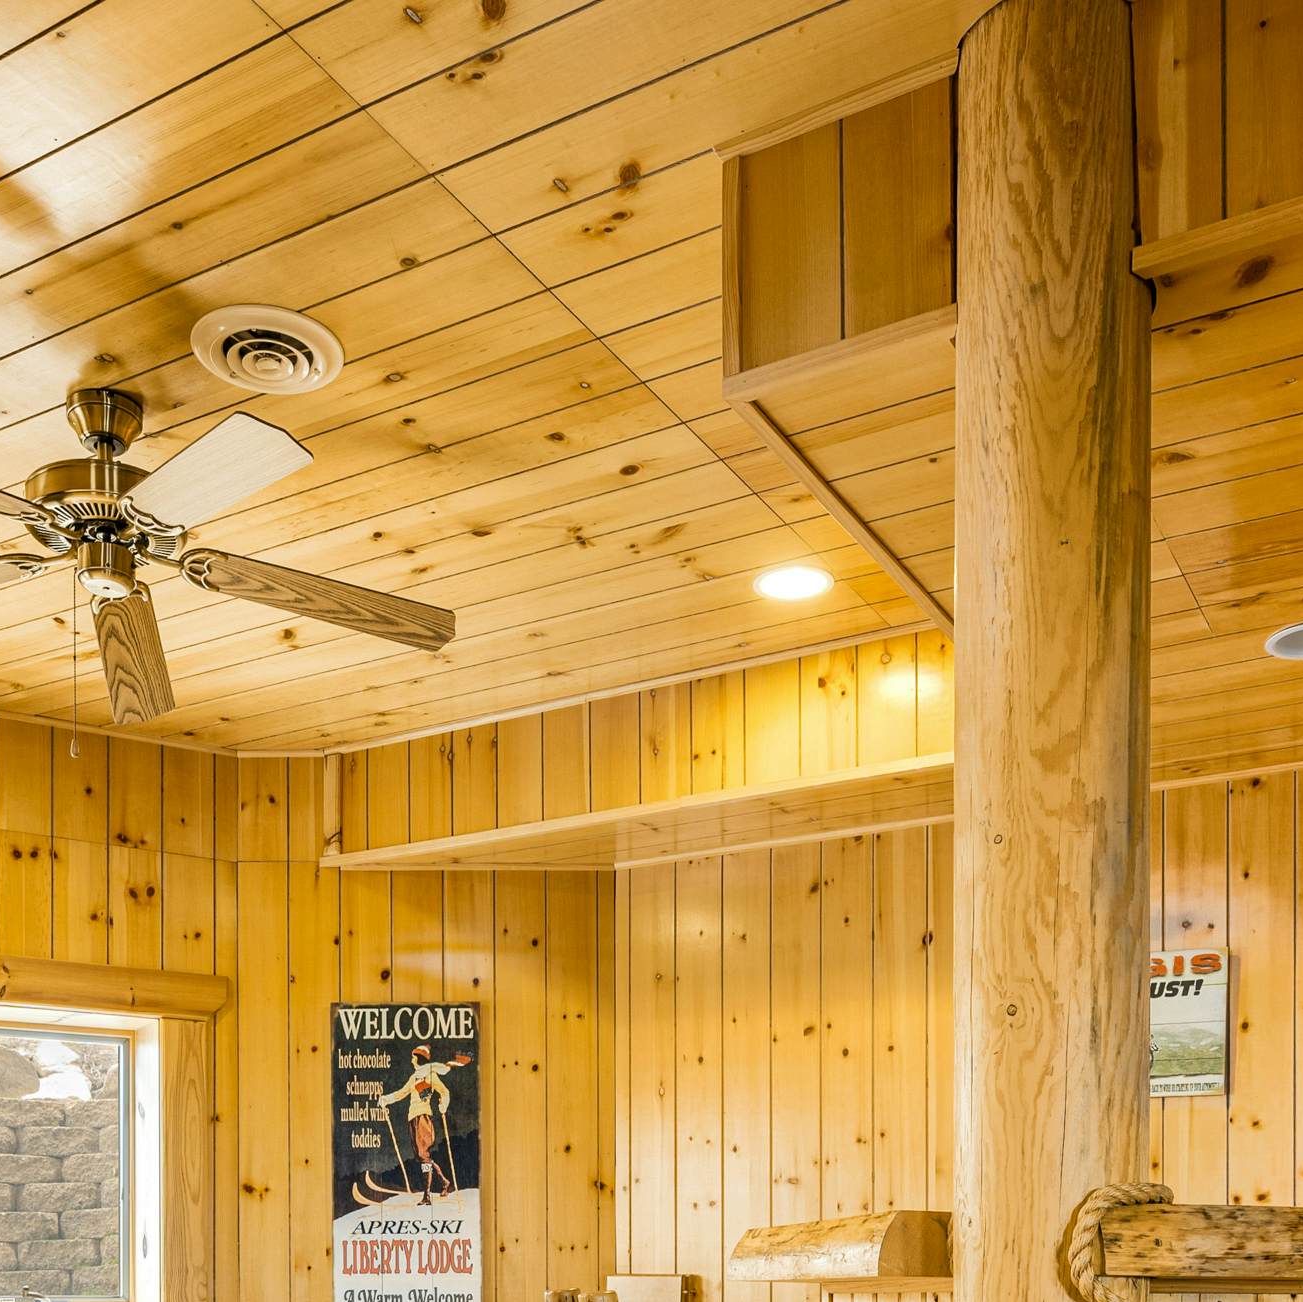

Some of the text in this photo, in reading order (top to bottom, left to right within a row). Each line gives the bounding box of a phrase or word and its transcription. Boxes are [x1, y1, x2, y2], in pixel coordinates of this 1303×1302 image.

[338, 1007, 474, 1040] WELCOME
[338, 1048, 391, 1069] hot chocolate
[346, 1074, 384, 1101] schnapps
[340, 1101, 369, 1122] mulled
[351, 1127, 381, 1148] toddies
[350, 1219, 465, 1235] APRES-SKI
[342, 1238, 474, 1276] LIBERTY LODGE
